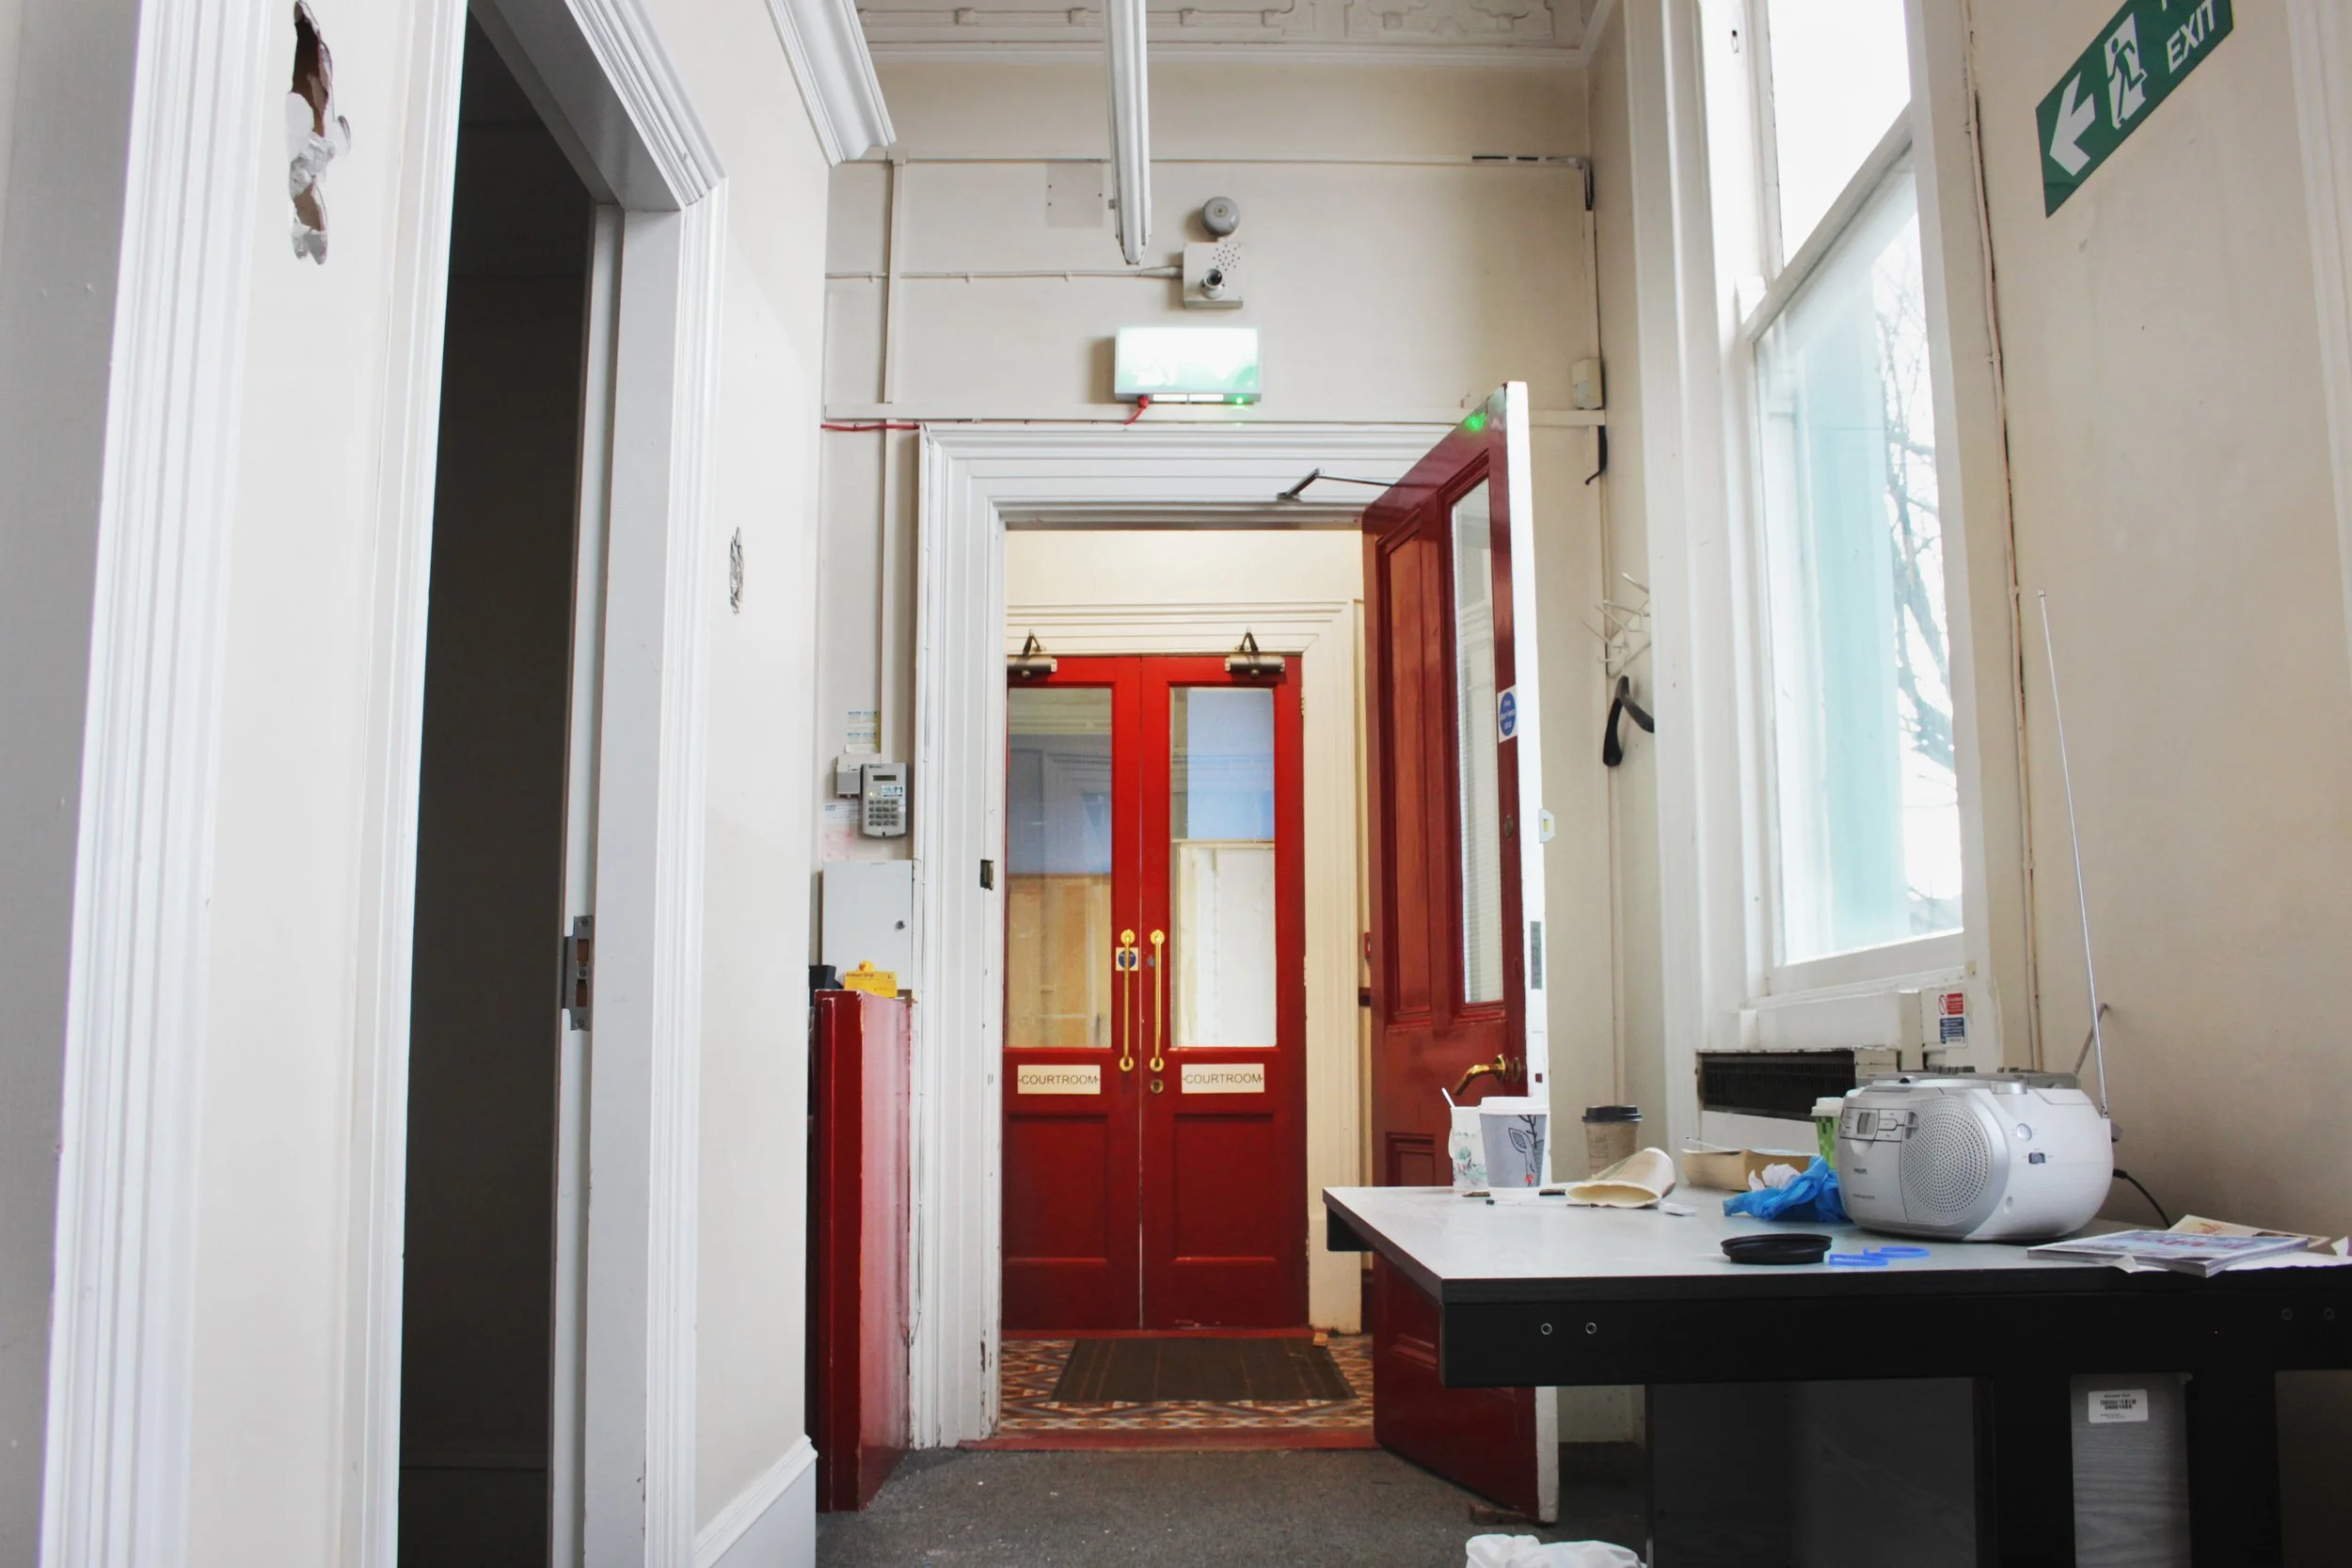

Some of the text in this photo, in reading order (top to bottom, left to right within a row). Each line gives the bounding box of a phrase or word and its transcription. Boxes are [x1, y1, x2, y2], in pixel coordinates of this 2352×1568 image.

[2166, 0, 2215, 74] EXIT
[1021, 1074, 1098, 1085] COURTROOM
[1184, 1073, 1262, 1085] COURTROOM
